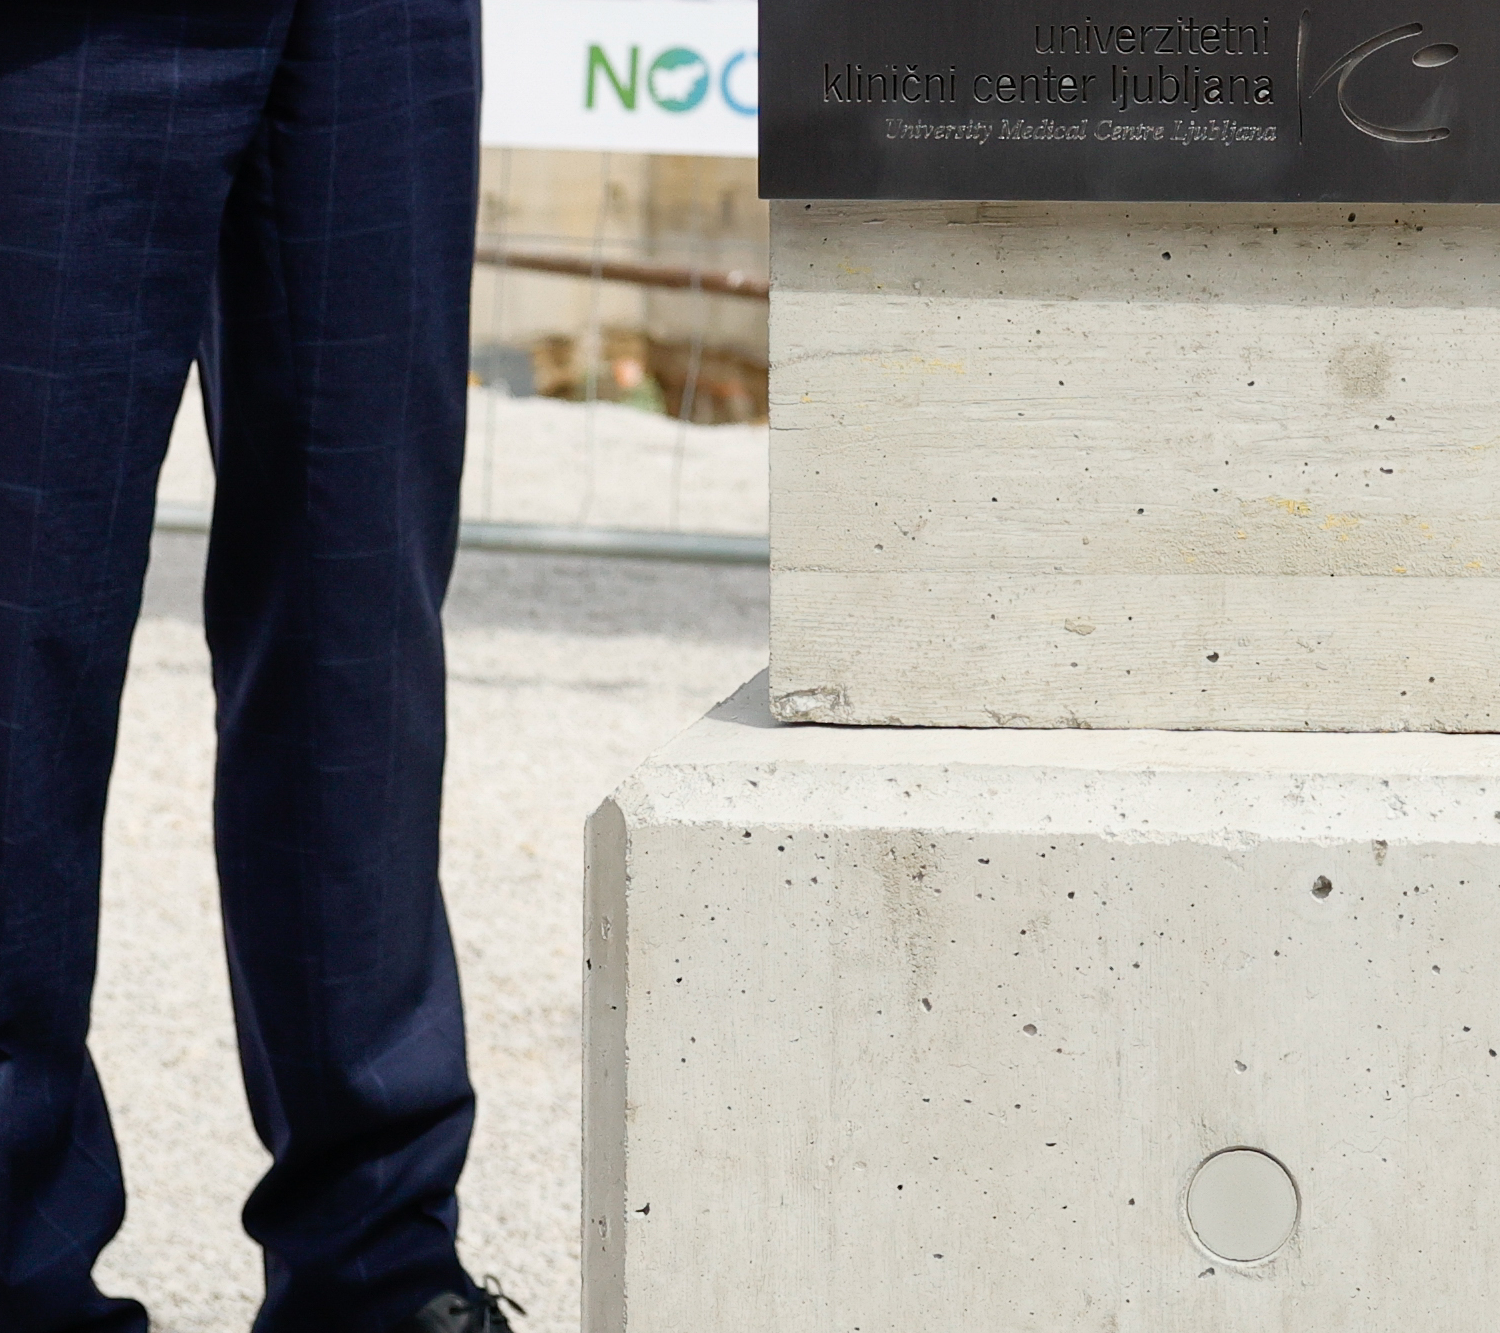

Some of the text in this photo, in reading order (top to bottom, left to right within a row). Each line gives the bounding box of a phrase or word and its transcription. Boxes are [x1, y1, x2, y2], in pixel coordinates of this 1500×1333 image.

[1034, 16, 1271, 56] univerzitetni
[822, 63, 1275, 113] klinični center ljubljana
[884, 117, 1278, 147] University Medical Centre Ljubljana
